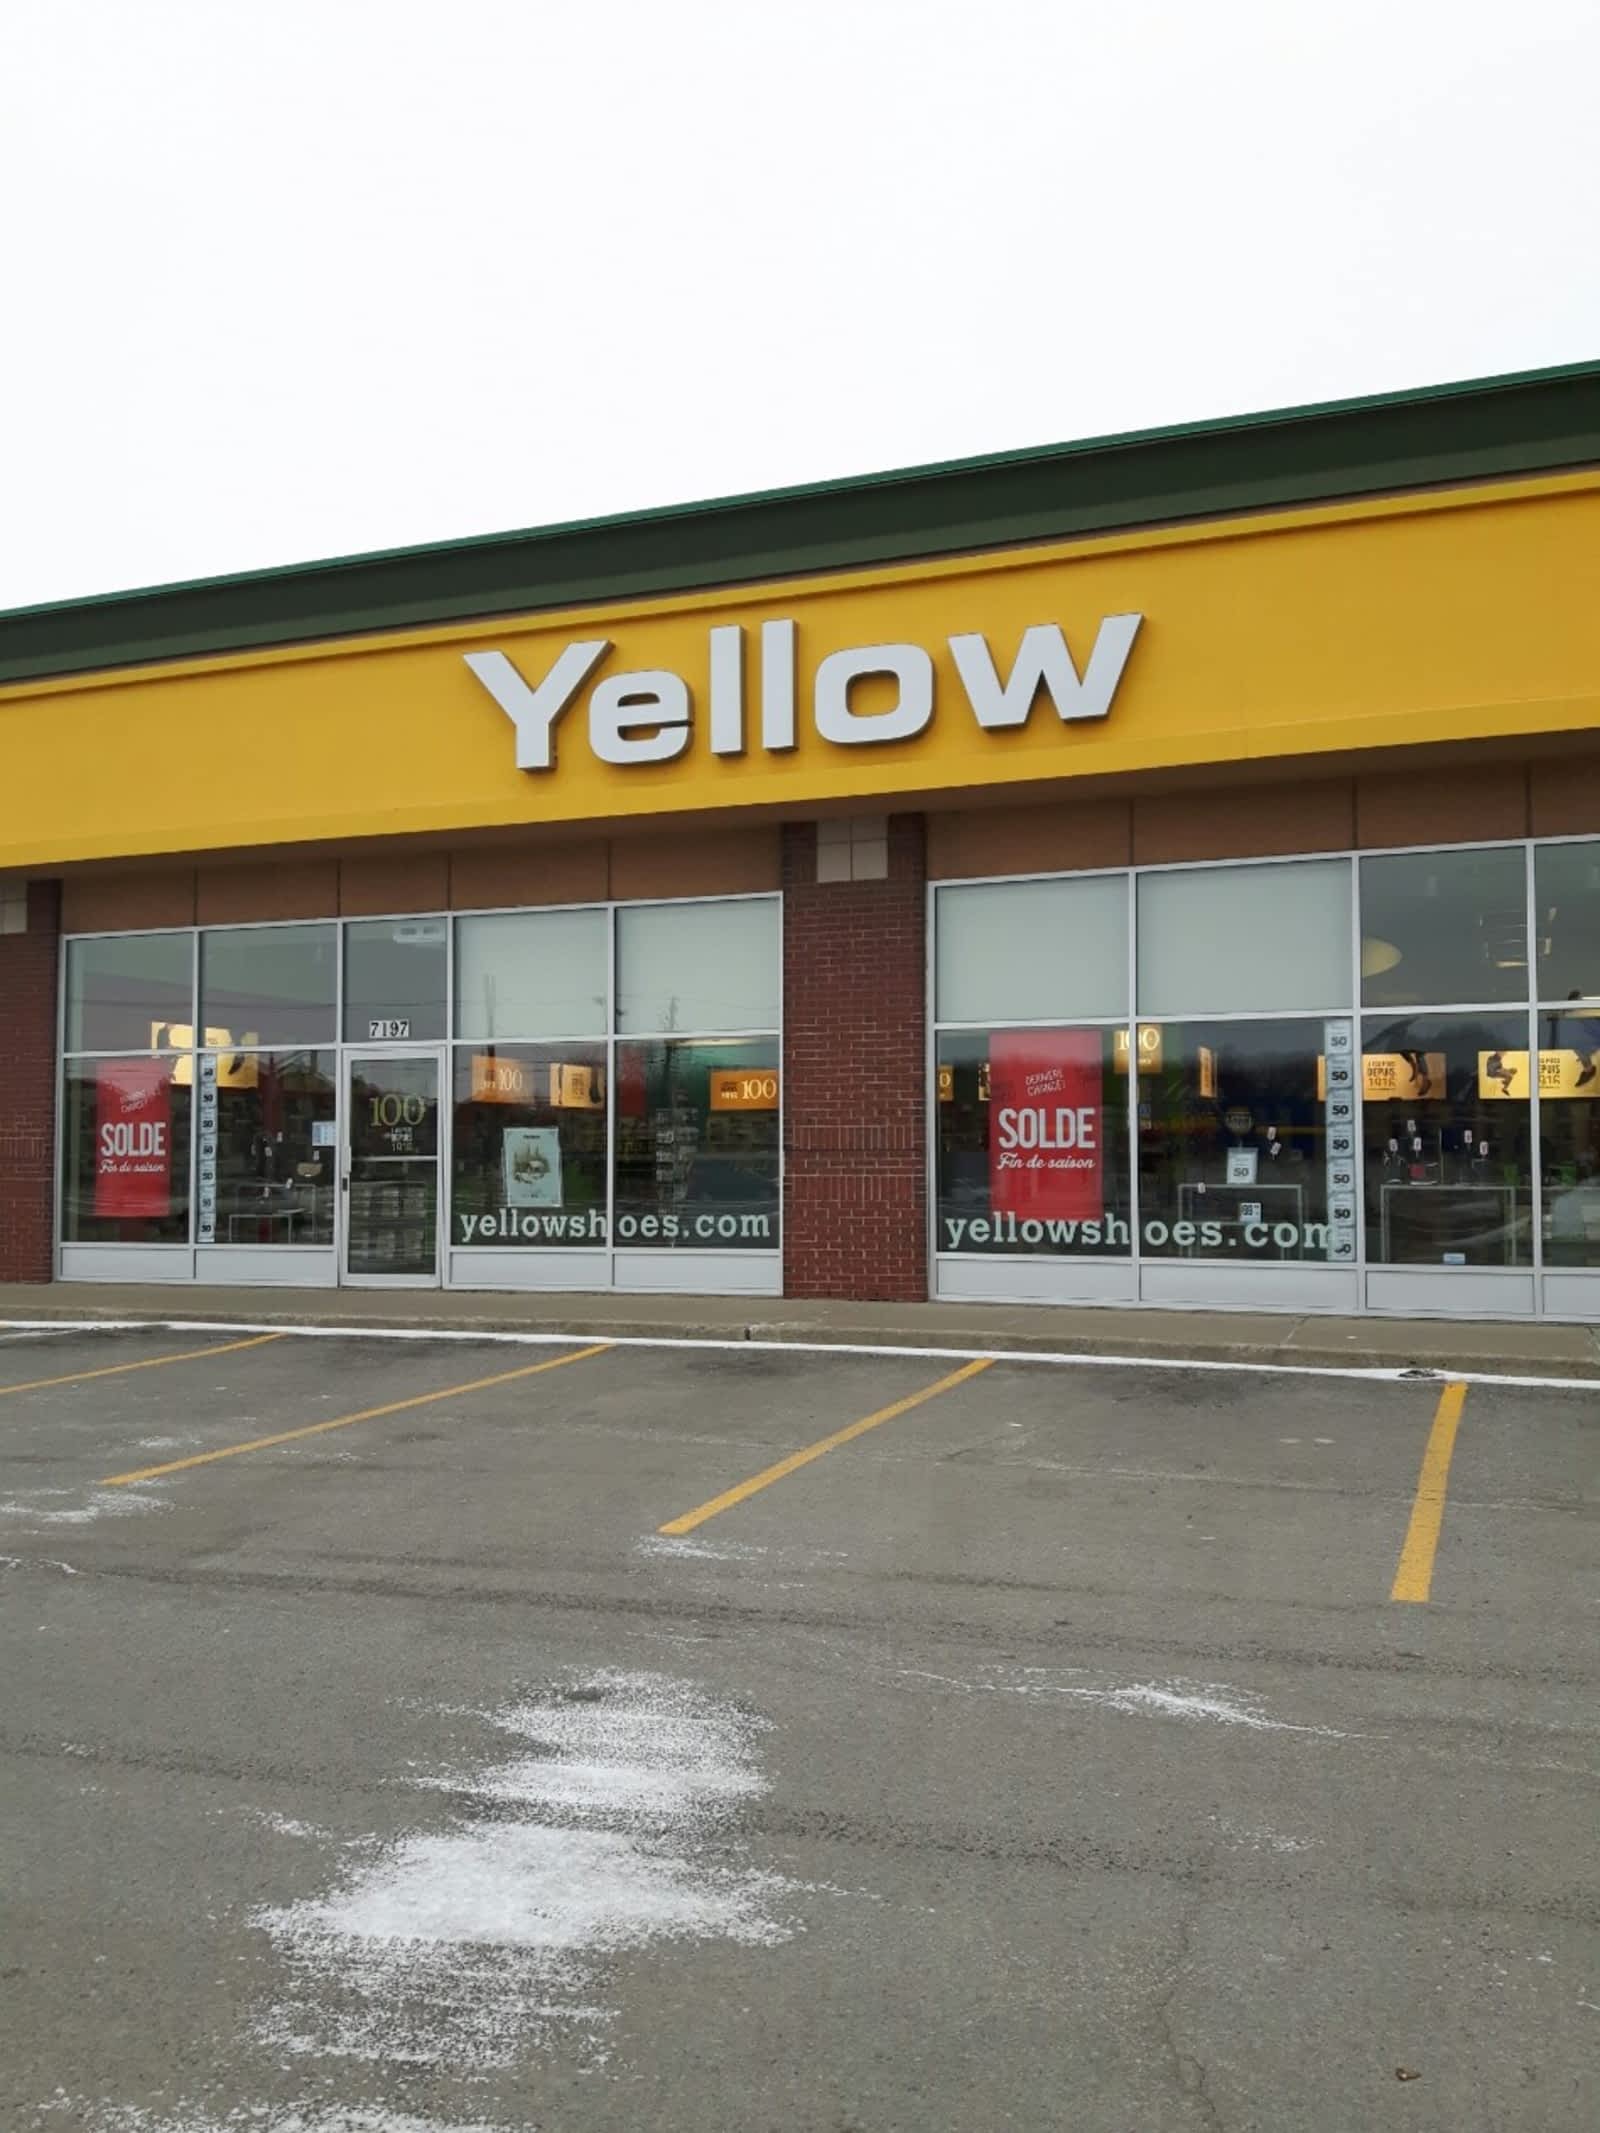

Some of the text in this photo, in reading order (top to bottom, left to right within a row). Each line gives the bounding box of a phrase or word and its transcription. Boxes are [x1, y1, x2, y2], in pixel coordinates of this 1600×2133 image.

[462, 613, 1145, 770] Yellow
[370, 1021, 409, 1037] 7197
[1331, 1036, 1348, 1047] 50
[1331, 1071, 1348, 1081] 50
[741, 1080, 777, 1099] 100
[369, 1094, 426, 1126] 100
[1332, 1105, 1349, 1115] 50
[998, 1108, 1096, 1148] SOLDE
[101, 1122, 166, 1157] SOLDE
[1332, 1139, 1349, 1150] 50
[997, 1152, 1096, 1170] Fin de saison
[1233, 1168, 1249, 1176] 50
[1333, 1174, 1350, 1184] 50
[1333, 1209, 1351, 1219] 50
[460, 1208, 771, 1242] yellowshoes.com
